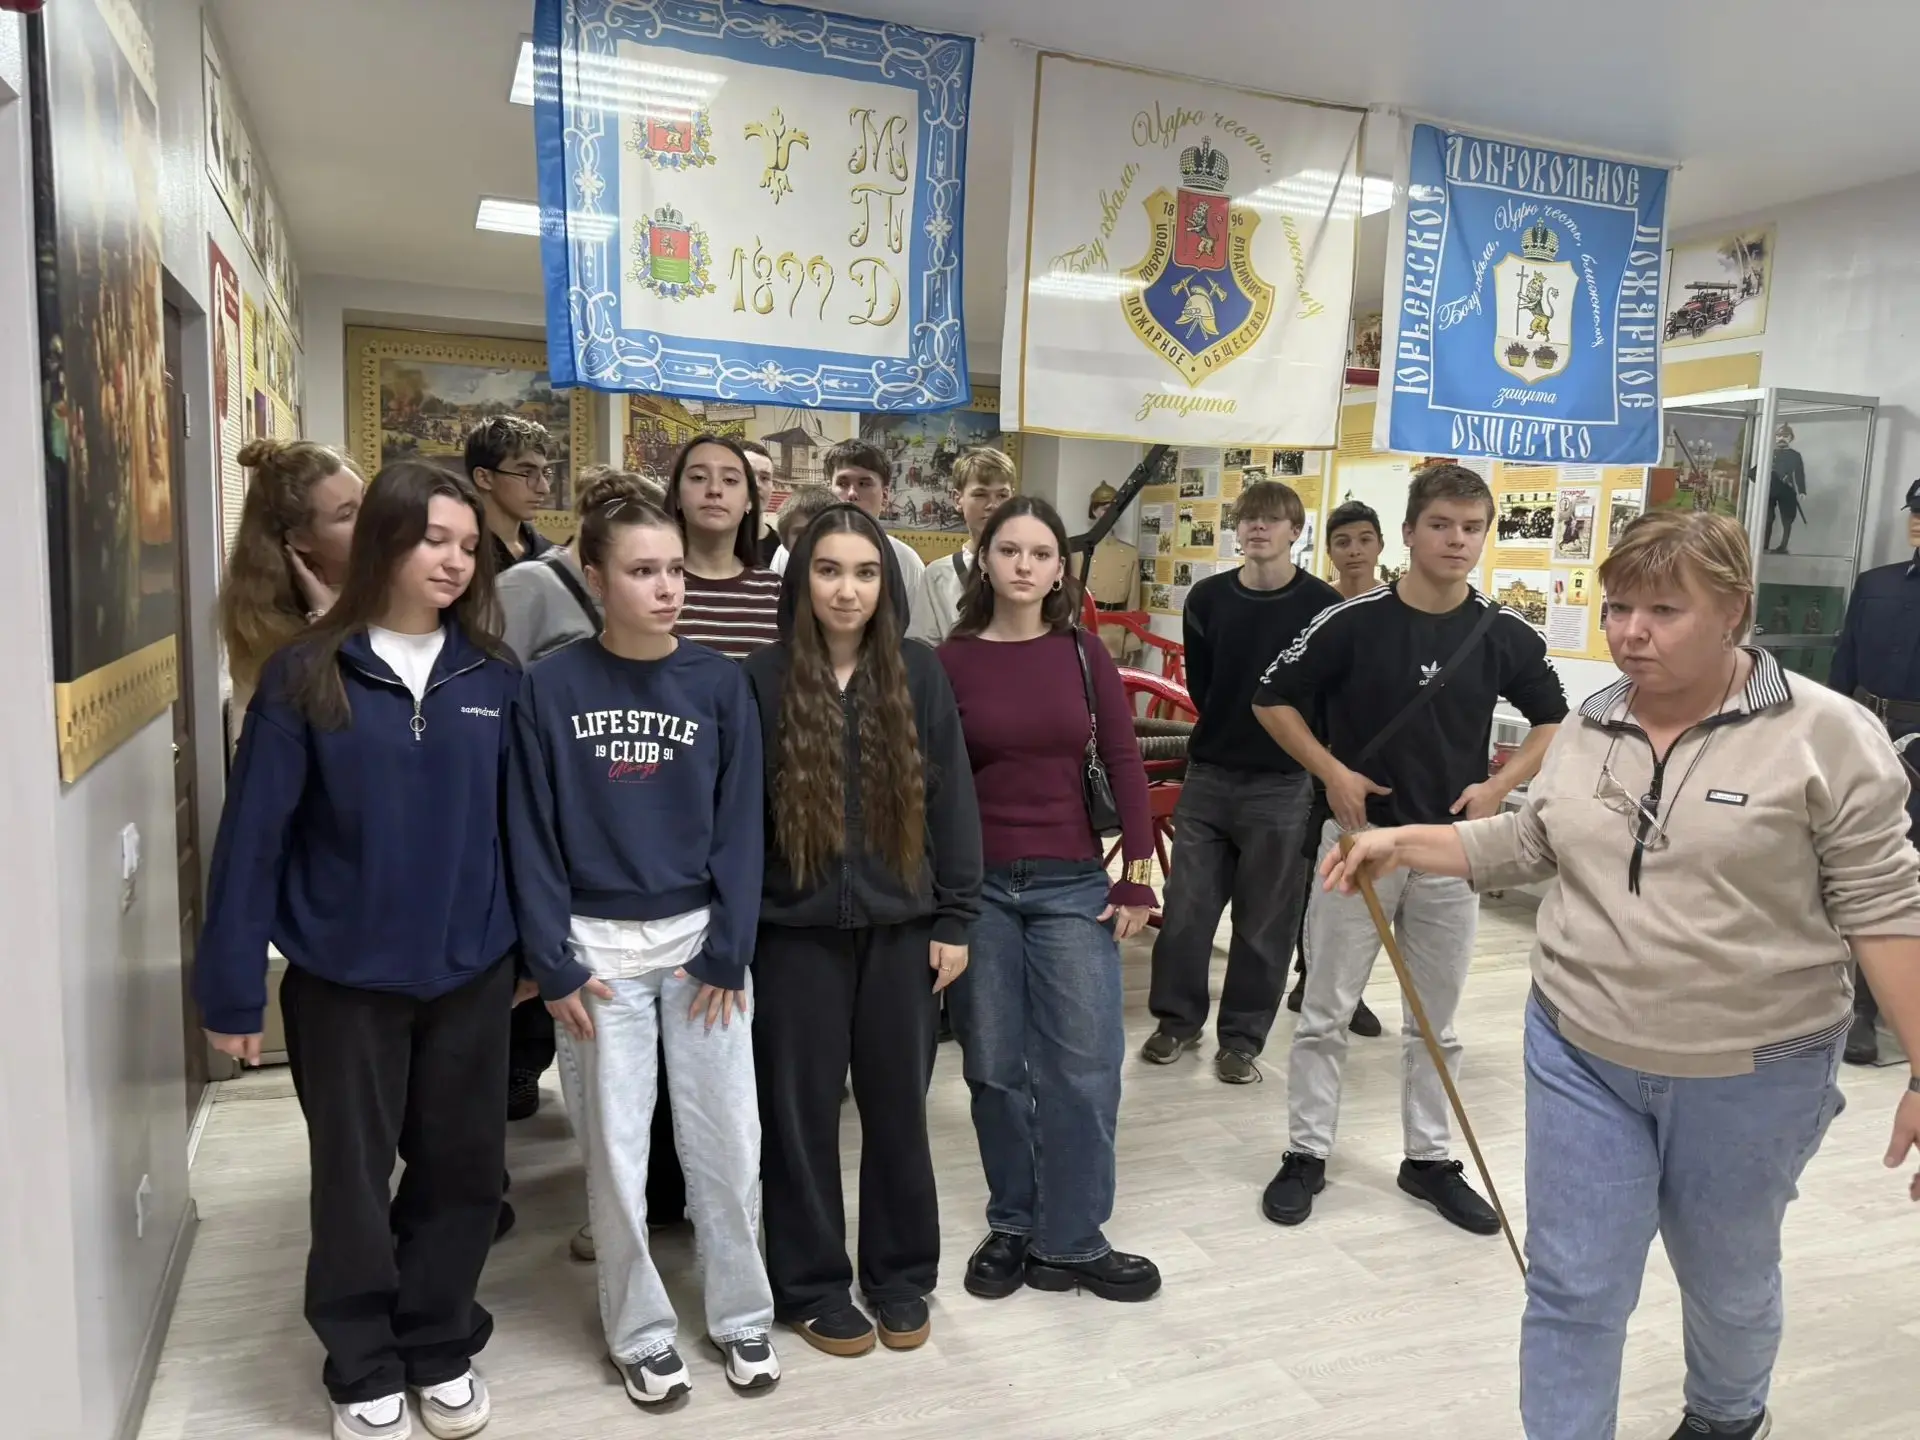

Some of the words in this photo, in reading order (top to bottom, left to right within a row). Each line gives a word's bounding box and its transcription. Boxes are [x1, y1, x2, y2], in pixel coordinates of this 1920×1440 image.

[1446, 136, 1640, 206] ДОБРОВОЛЬНОЕ
[1132, 100, 1205, 149] Царю
[1277, 210, 1325, 320] ижнему
[1394, 184, 1445, 394] ЮРЬЕВСКОЕ
[1437, 291, 1482, 330] Богу
[1494, 198, 1538, 232] Царю
[1127, 295, 1186, 365] ПОЖАРНОЕ
[1204, 311, 1265, 368] ОБЩЕСТВО
[1618, 225, 1660, 408] ПОЖАРНОЕ
[1135, 393, 1238, 421] защита
[1492, 387, 1558, 408] защита
[1452, 414, 1591, 459] ОБЩЕСТВО
[595, 745, 606, 757] 19
[611, 740, 660, 763] CLUB
[663, 748, 674, 760] 91
